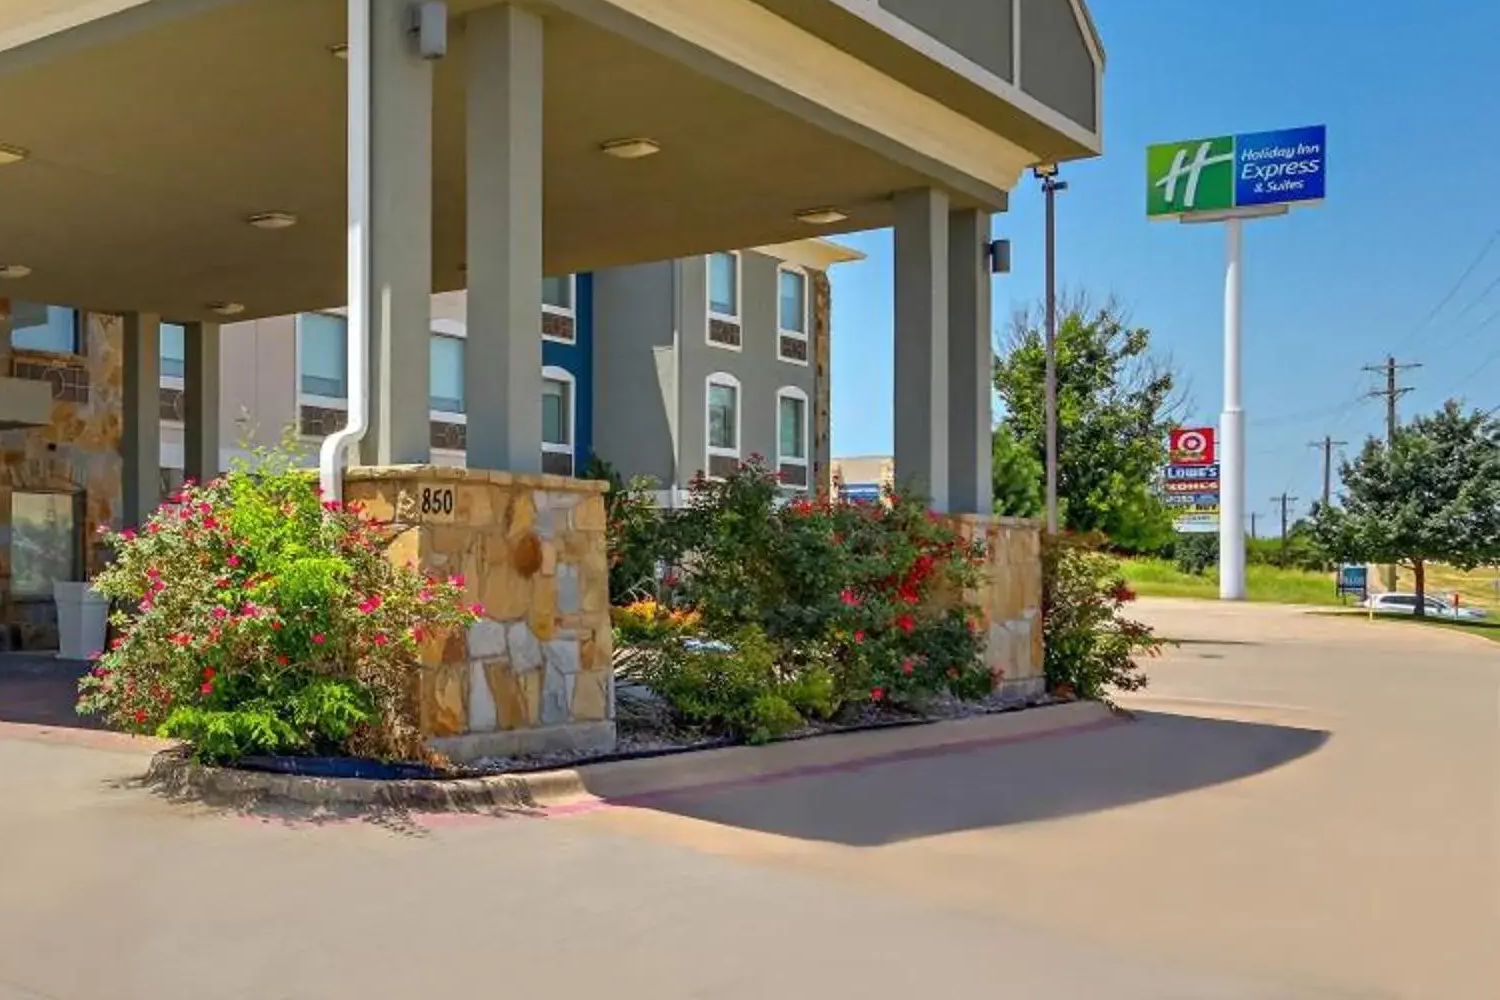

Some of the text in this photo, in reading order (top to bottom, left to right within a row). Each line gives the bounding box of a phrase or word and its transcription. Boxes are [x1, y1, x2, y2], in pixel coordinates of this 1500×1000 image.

[1241, 143, 1320, 162] Holiday Inn
[1156, 141, 1232, 207] H
[1241, 158, 1320, 181] Express
[1253, 179, 1304, 193] & Suites
[422, 487, 453, 515] 850
